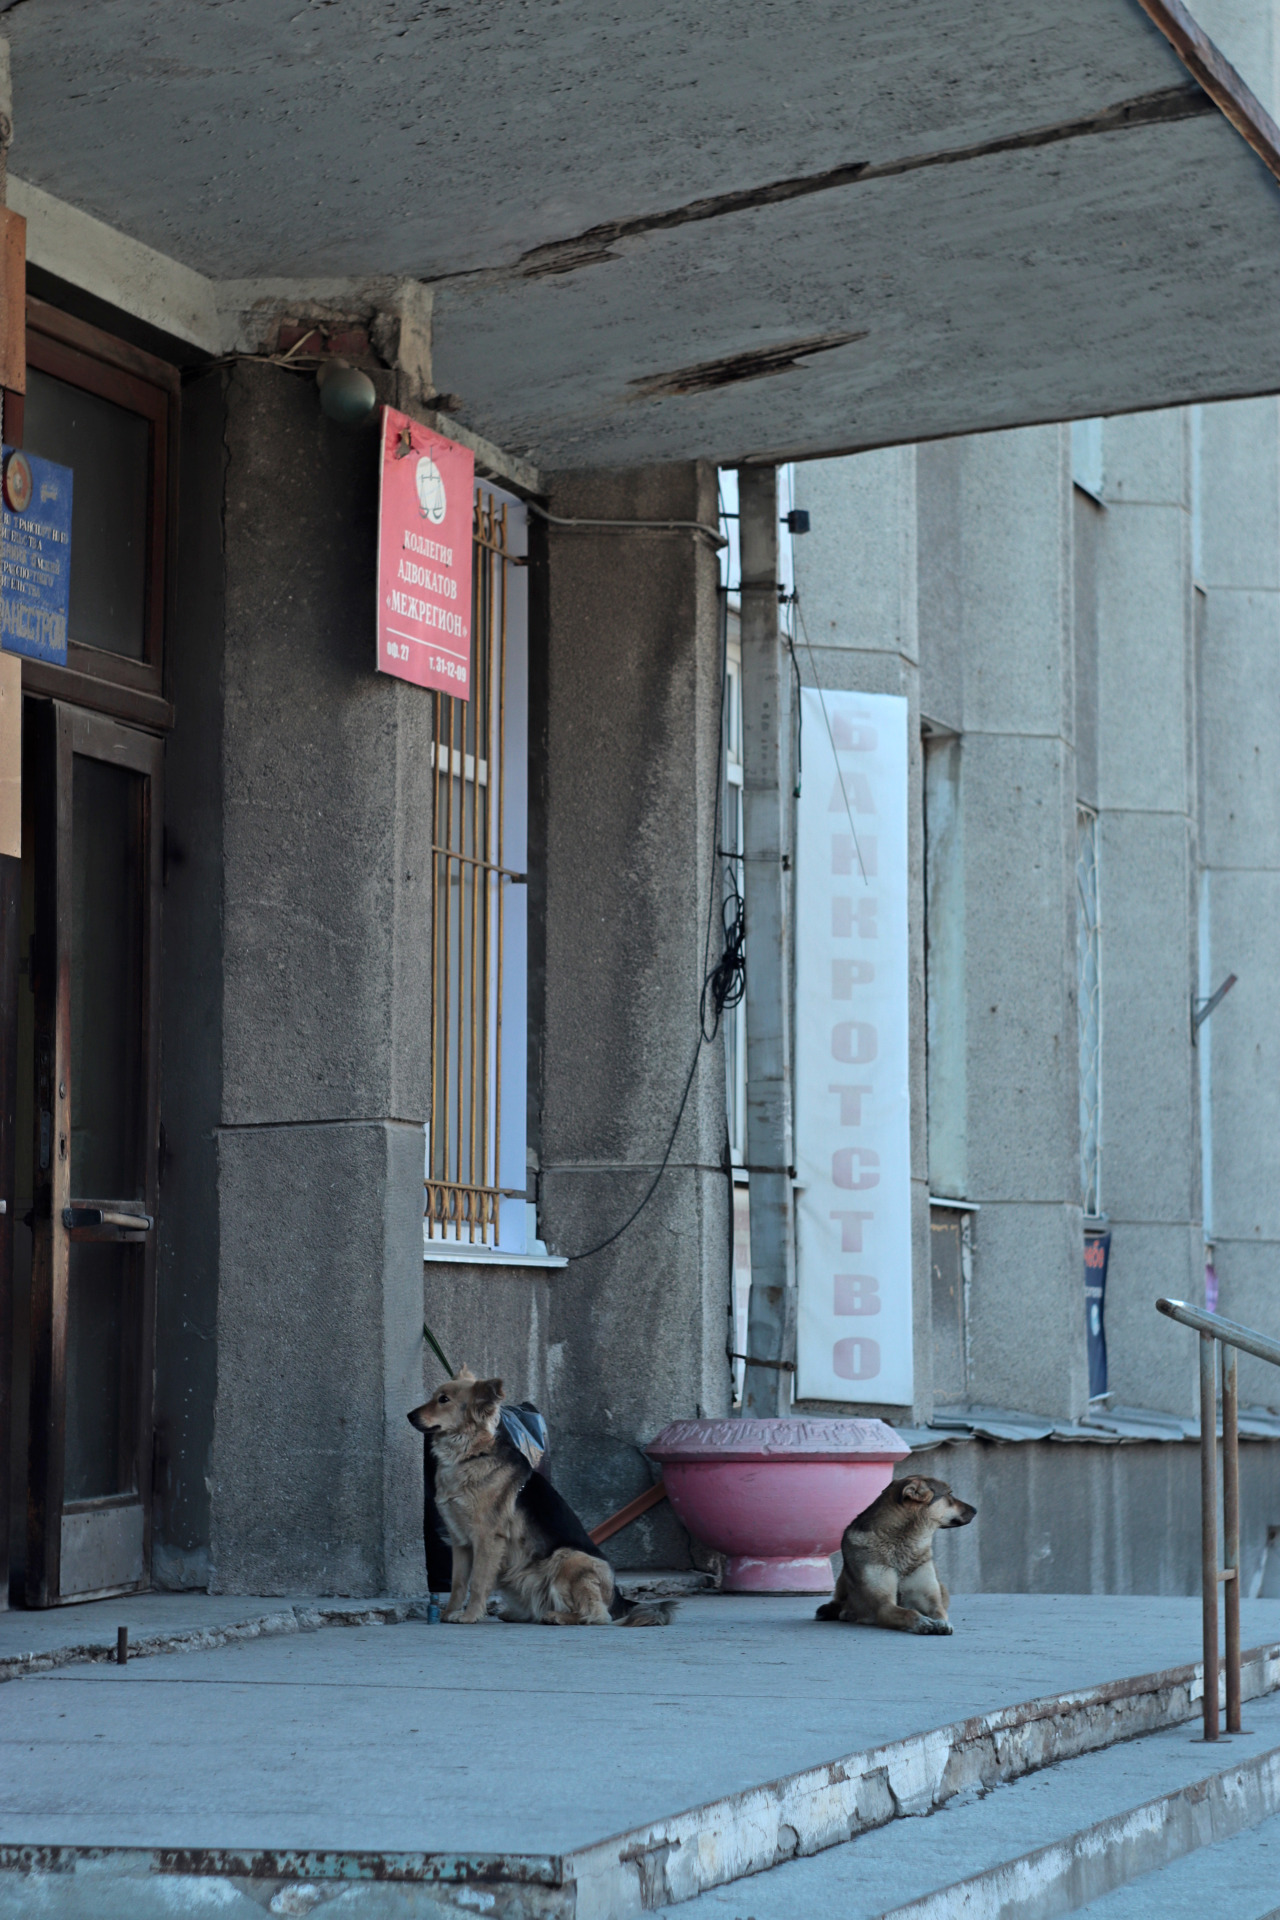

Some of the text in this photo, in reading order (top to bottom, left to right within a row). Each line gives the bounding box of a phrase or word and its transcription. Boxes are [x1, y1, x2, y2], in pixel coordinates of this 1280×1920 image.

[404, 530, 453, 566] КОЛЛЕГИЯ
[397, 559, 457, 600] АДВОКАТОВ
[386, 589, 467, 638] «МЕЖРЕГИОН»
[401, 644, 409, 662] 27
[436, 656, 467, 683] 31-12-09
[827, 710, 881, 1381] БАНКРОТСТВО
